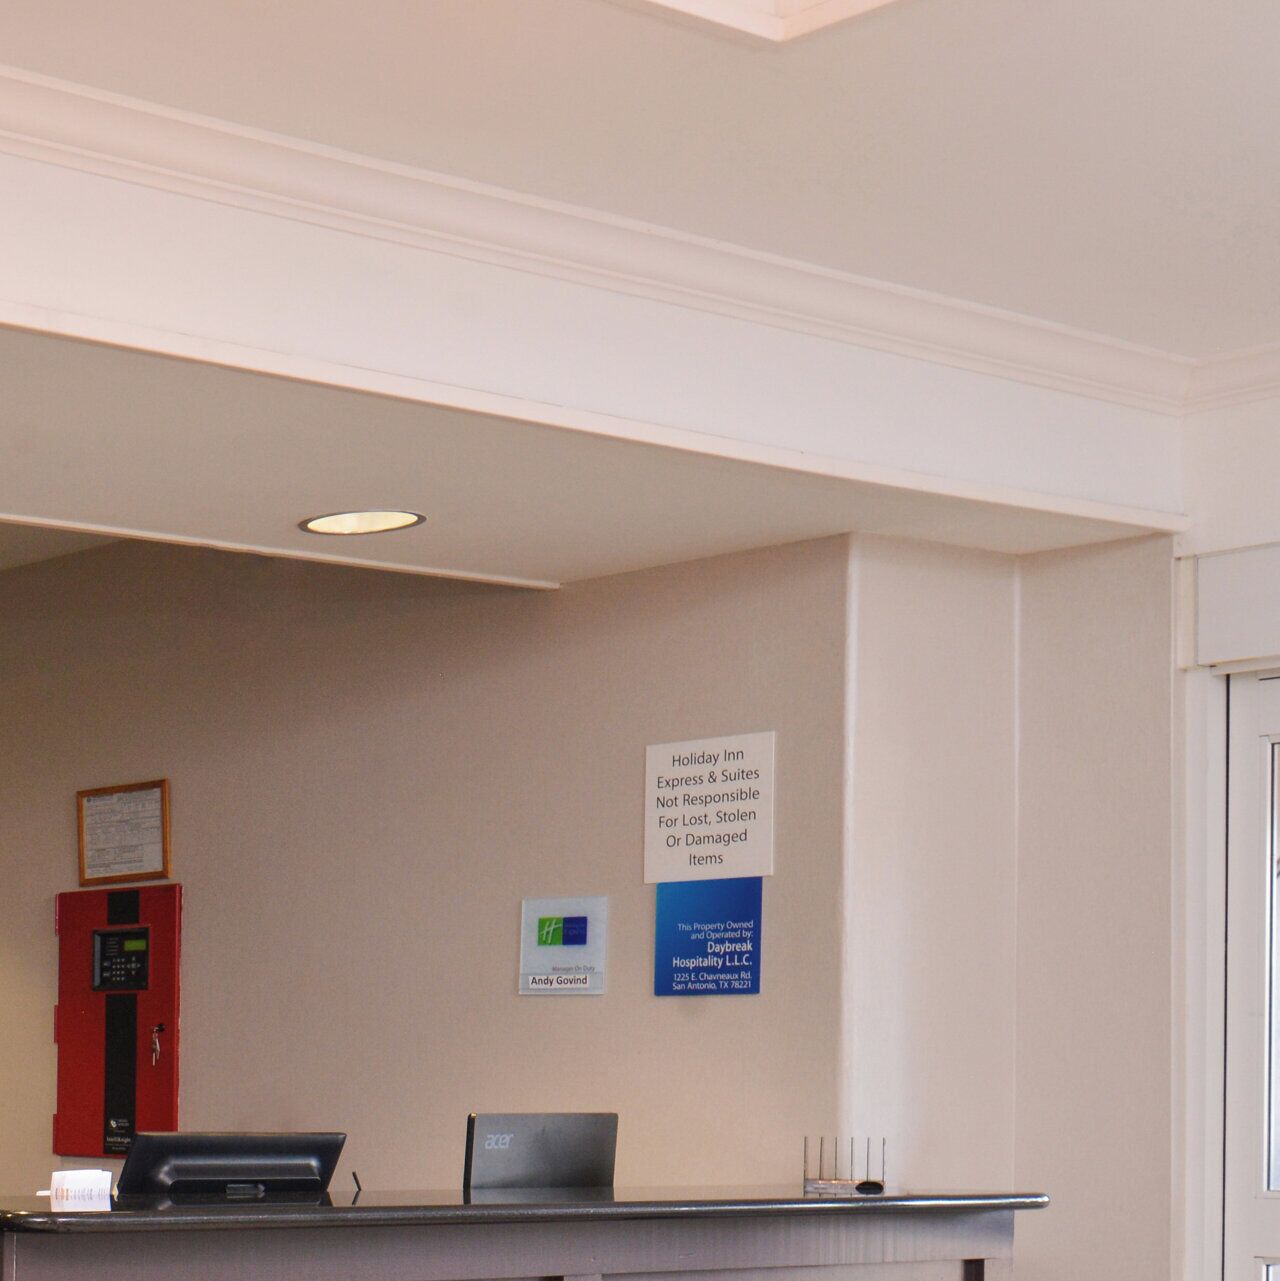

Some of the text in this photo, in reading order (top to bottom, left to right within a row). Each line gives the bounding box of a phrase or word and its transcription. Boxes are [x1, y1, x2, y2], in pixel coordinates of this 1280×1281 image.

[672, 749, 744, 767] Holiday Inn
[657, 768, 760, 790] Express & Suites
[656, 787, 760, 808] Not Responsible
[659, 809, 756, 828] For Lost, Stolen
[666, 829, 748, 848] Or Damaged
[689, 853, 724, 866] Items
[678, 920, 754, 931] This Property Owned
[691, 931, 705, 940] and
[706, 930, 741, 940] Operated
[707, 940, 753, 955] Daybreak
[672, 954, 753, 970] Hospitality L.L.C.
[530, 976, 588, 986] Andy Govind
[672, 982, 686, 990] San
[719, 981, 729, 989] TX
[484, 1134, 514, 1150] acer
